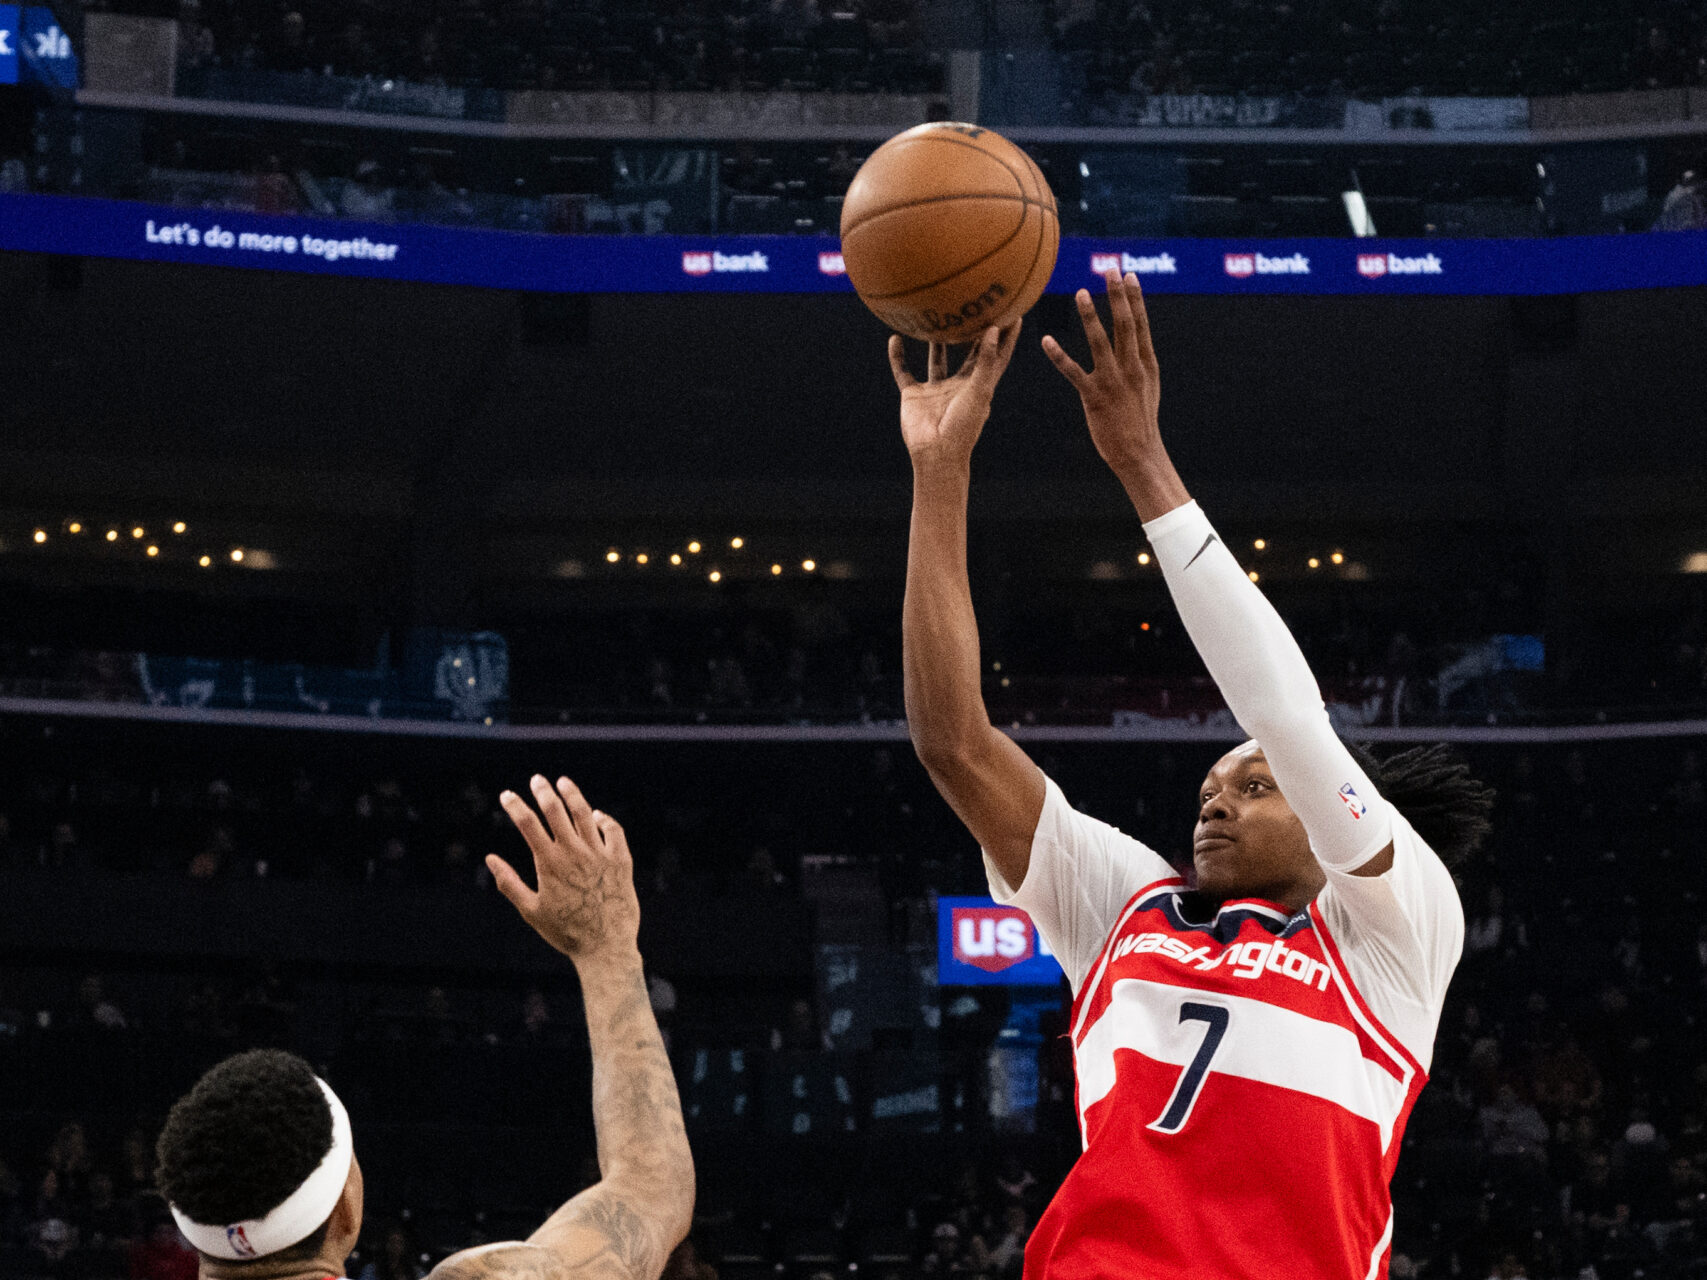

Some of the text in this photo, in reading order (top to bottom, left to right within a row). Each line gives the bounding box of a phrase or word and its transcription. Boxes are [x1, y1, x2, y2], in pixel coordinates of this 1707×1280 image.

[203, 225, 235, 248] do
[239, 233, 298, 254] more
[301, 234, 399, 261] together
[958, 917, 1027, 958] us
[1145, 1001, 1230, 1135] 7
